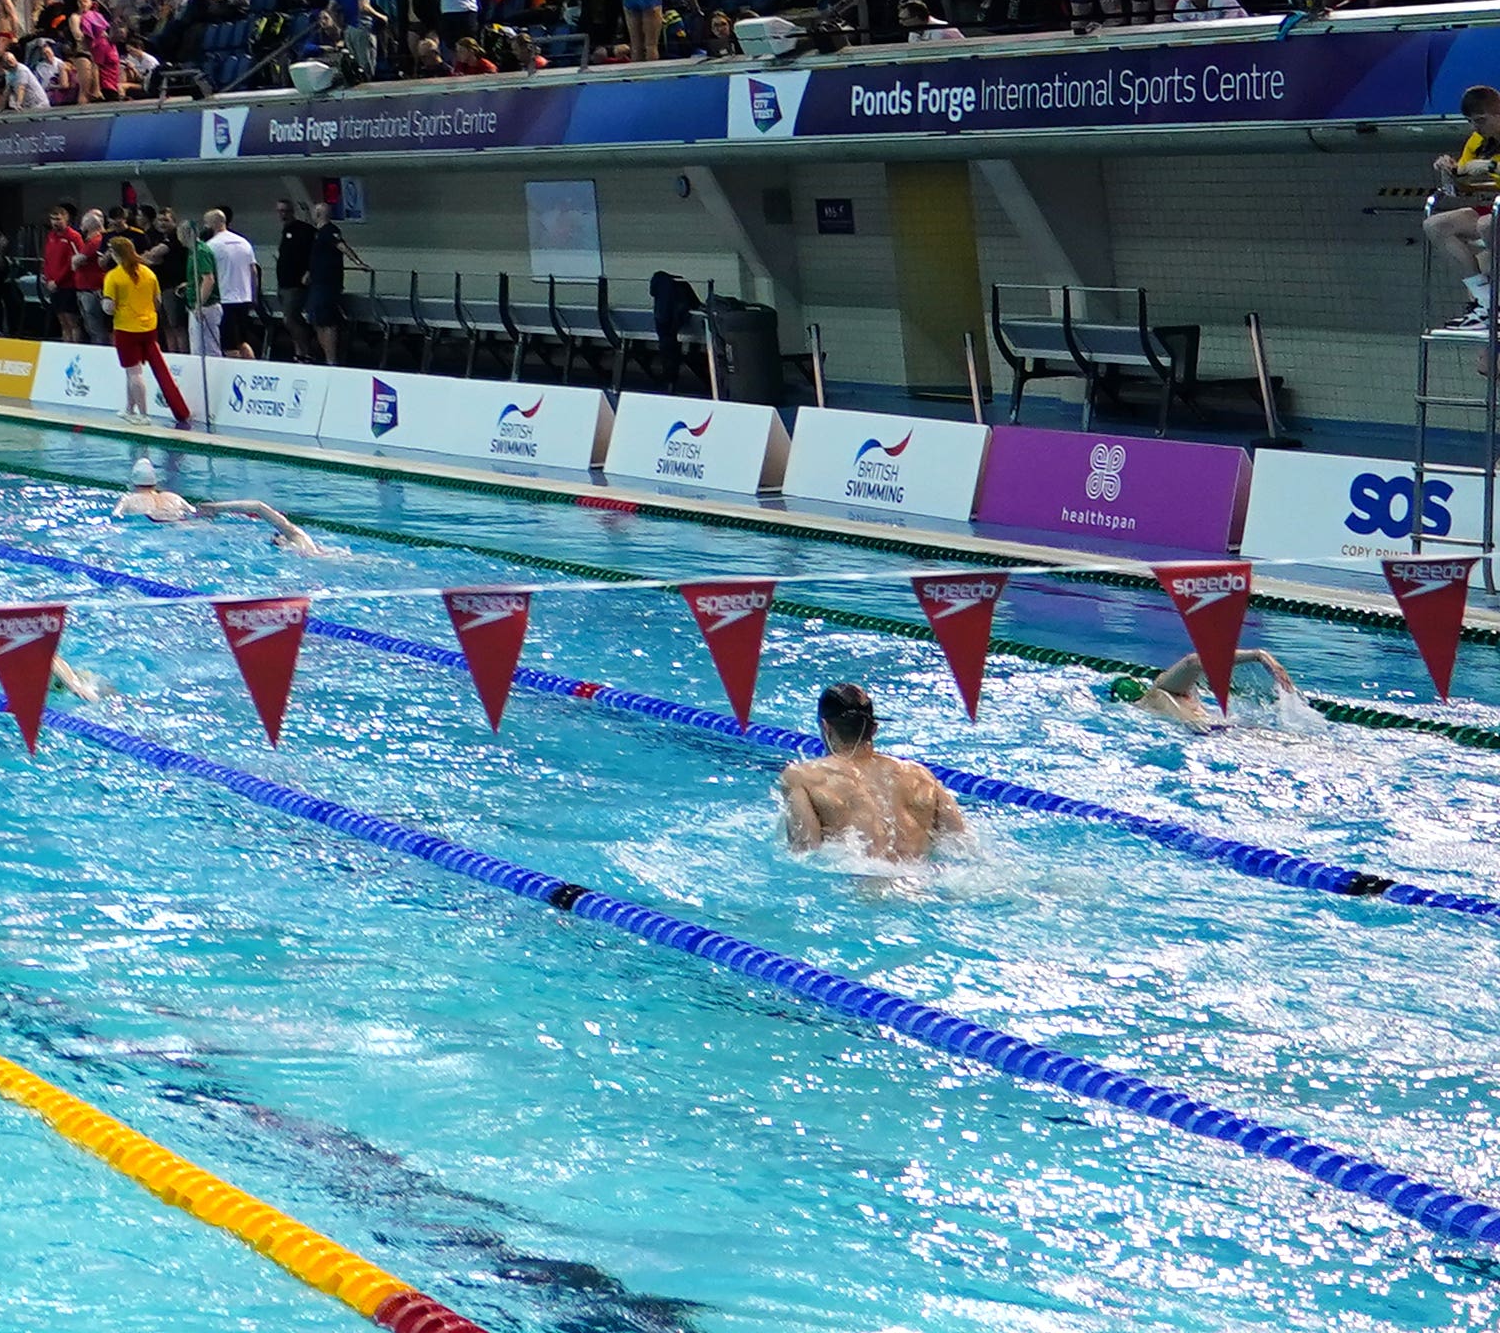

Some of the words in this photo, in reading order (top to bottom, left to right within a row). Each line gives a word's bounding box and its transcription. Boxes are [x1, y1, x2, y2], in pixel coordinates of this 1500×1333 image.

[851, 84, 911, 116] Ponds
[918, 81, 975, 122] Forge
[980, 72, 1113, 111] International
[1118, 68, 1195, 115] Sports
[1202, 64, 1284, 102] Centre
[269, 119, 304, 142] Ponds
[306, 117, 339, 146] Forge
[339, 109, 411, 139] International
[413, 108, 452, 144] Sports
[453, 108, 497, 135] Centre
[249, 375, 281, 393] SPORT
[246, 399, 285, 416] SYSTEMS
[500, 422, 533, 441] BRITISH
[490, 438, 538, 458] SWIMMING
[666, 440, 702, 460] BRITISH
[655, 458, 705, 480] SWIMMING
[857, 460, 900, 482] BRITISH
[845, 479, 905, 504] SWIMMING
[1344, 472, 1454, 539] SOS
[1061, 506, 1136, 531] healthspan
[1341, 544, 1371, 558] COPY
[1392, 561, 1466, 582] speedo
[923, 580, 996, 603] speedo
[1172, 573, 1246, 598] speedo
[696, 590, 767, 616] speedo
[225, 606, 301, 629] speedo
